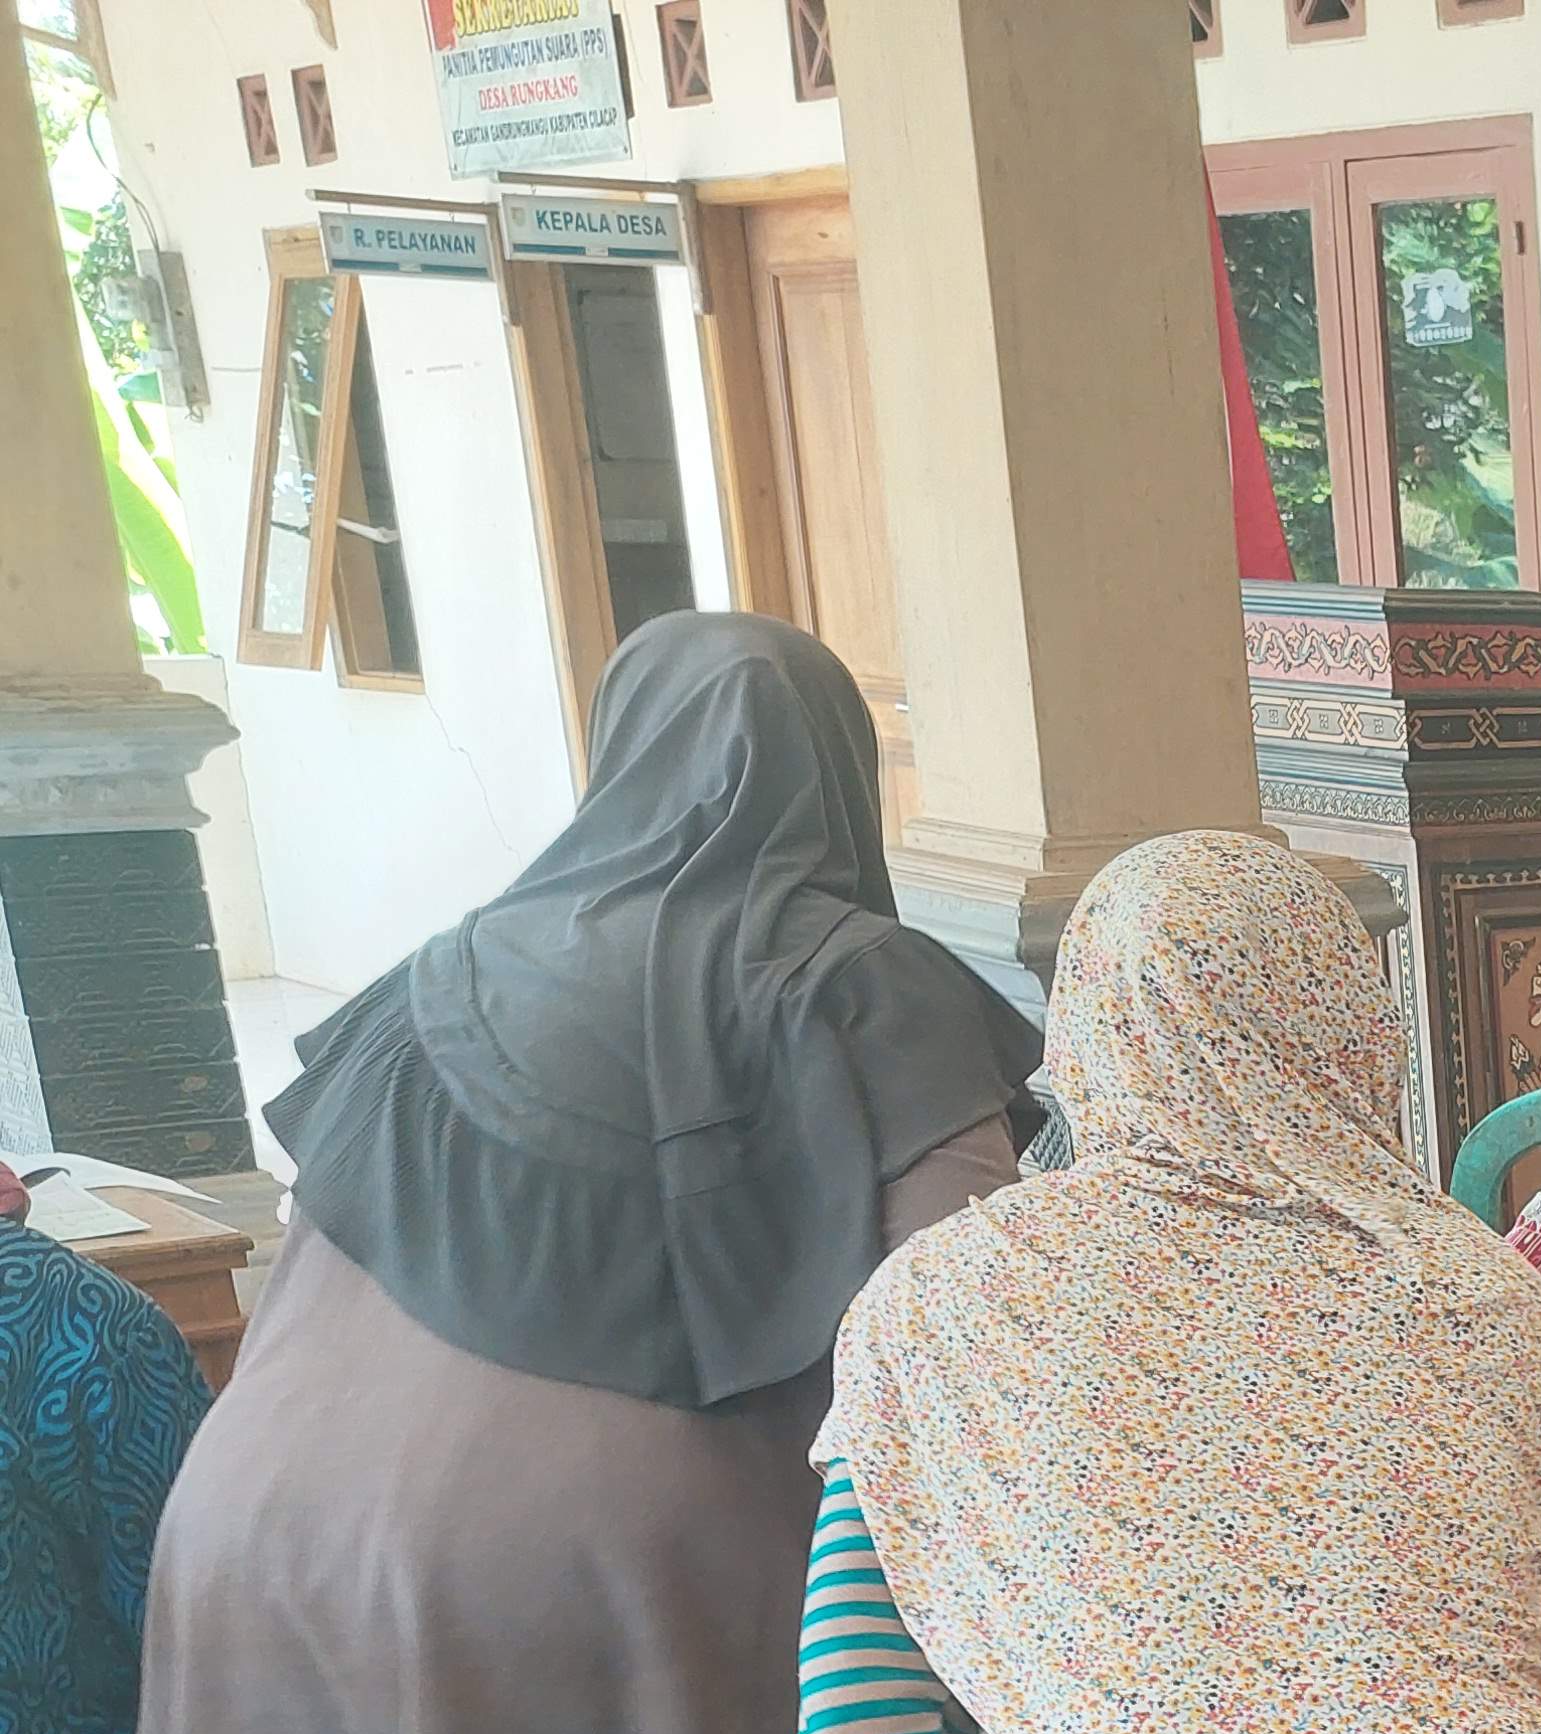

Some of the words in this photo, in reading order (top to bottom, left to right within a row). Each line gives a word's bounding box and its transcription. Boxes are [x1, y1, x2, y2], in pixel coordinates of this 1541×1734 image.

[478, 38, 545, 73] PEMUNGUTAN
[545, 31, 580, 62] SUARA
[580, 27, 608, 60] (PPS)
[478, 87, 509, 110] DESA
[510, 75, 578, 106] RUNGKANG
[452, 126, 490, 147] KECAMATAN
[549, 111, 588, 134] KABUPATEN
[588, 107, 617, 129] CILACAP
[536, 209, 612, 233] KEPALA
[616, 214, 667, 236] DESA
[353, 228, 372, 248] R.
[375, 229, 476, 254] PELAYANAN
